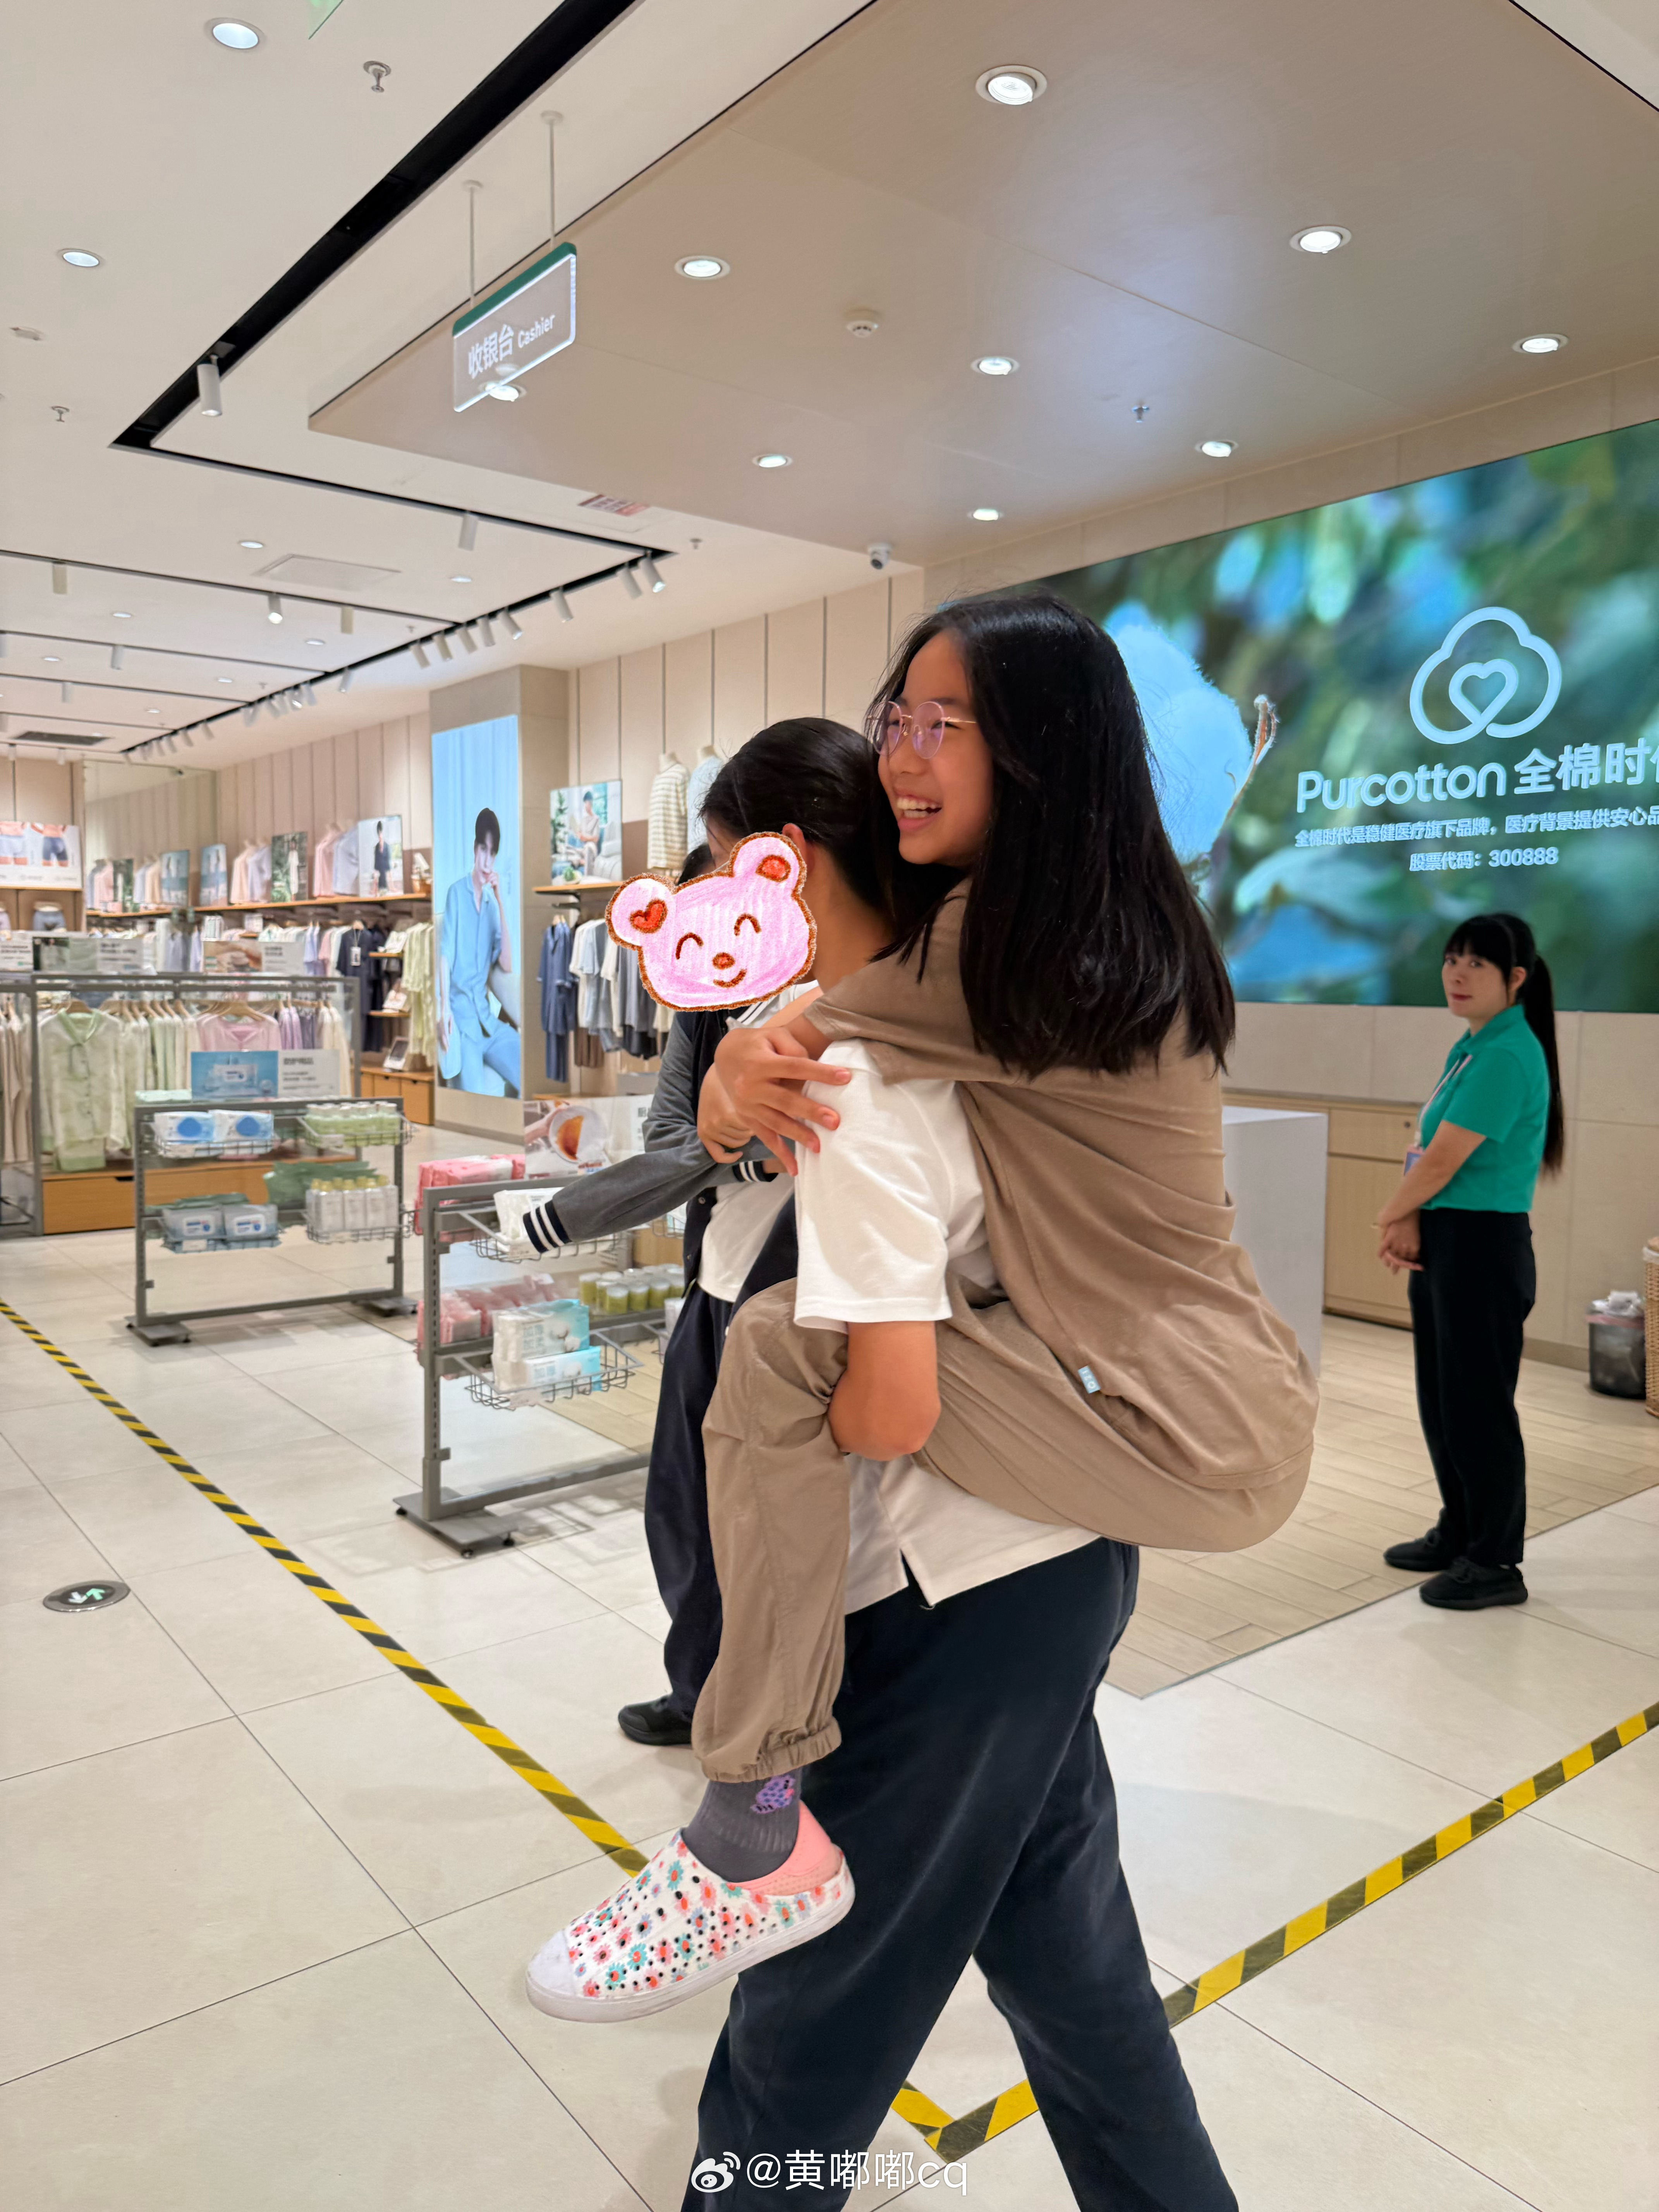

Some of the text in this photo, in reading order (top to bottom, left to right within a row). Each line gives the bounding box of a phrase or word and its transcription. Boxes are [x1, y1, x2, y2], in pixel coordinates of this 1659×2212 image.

[468, 314, 555, 379] 收银台 Cashier
[1297, 762, 1506, 813] Purcotton
